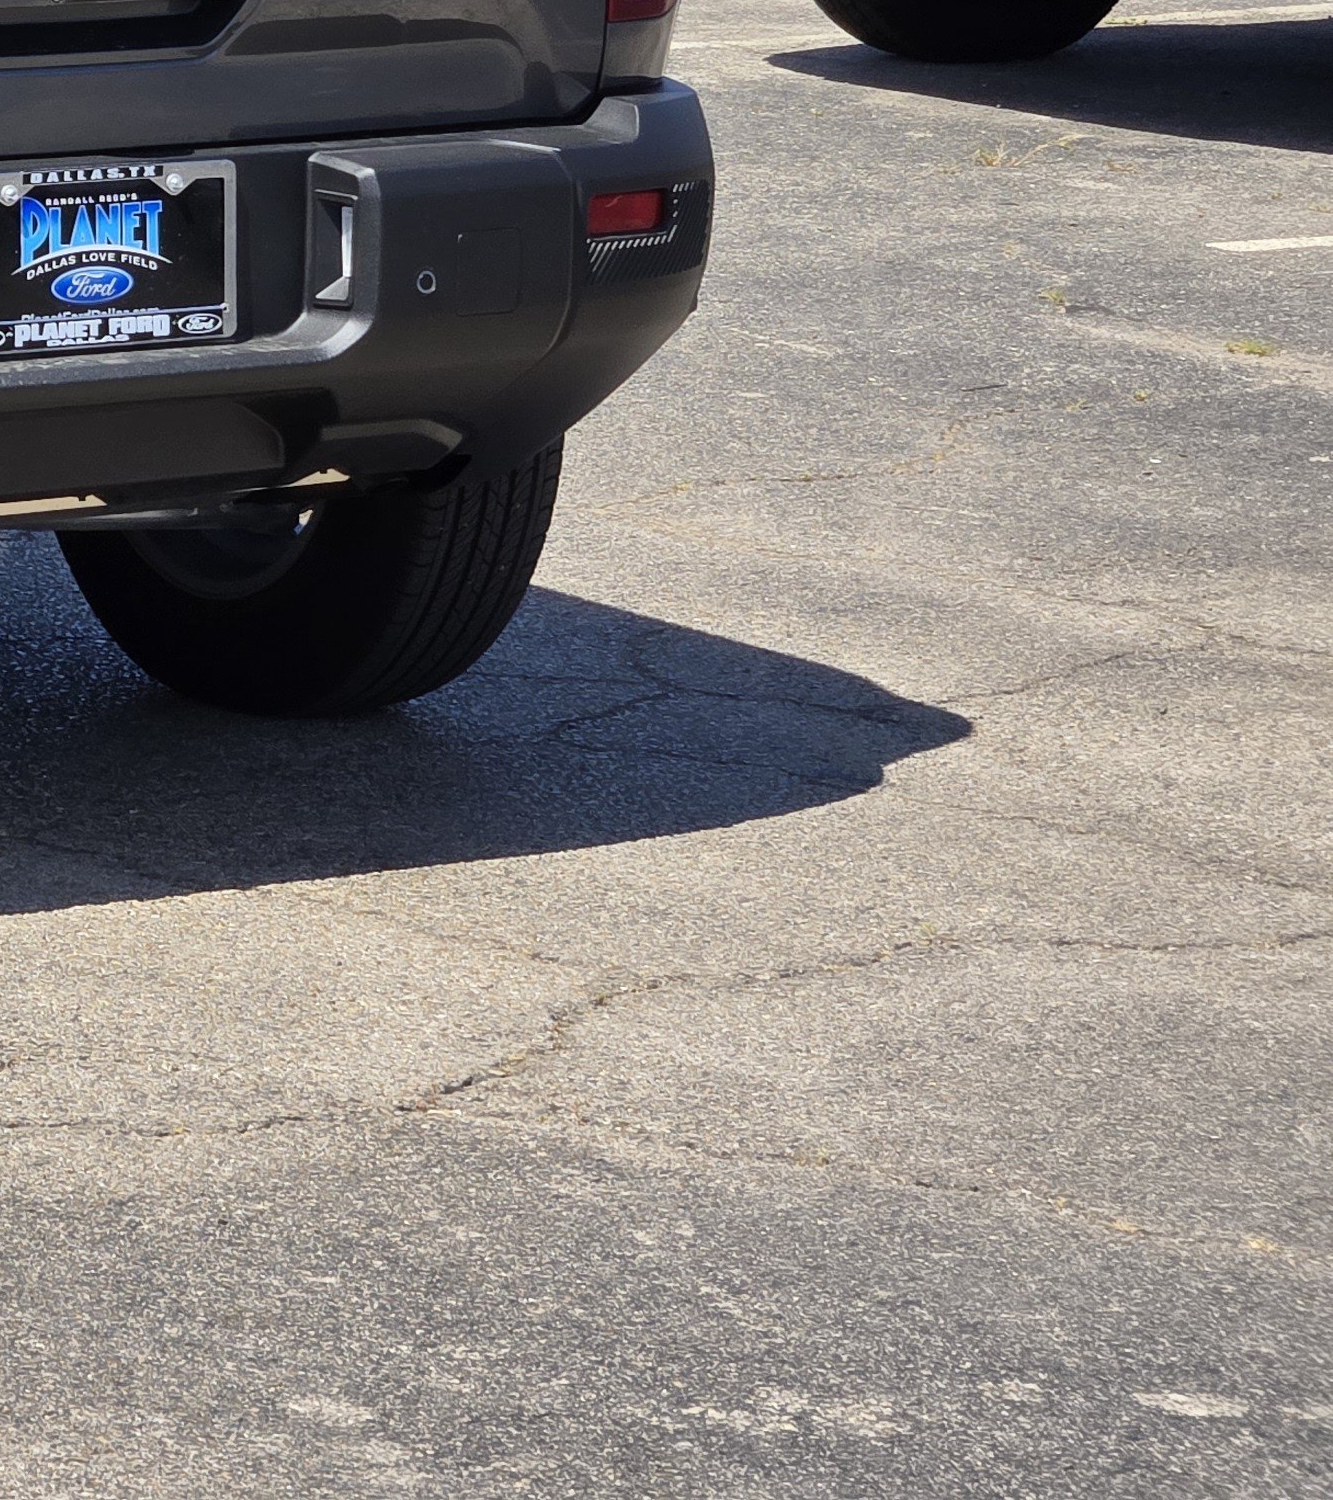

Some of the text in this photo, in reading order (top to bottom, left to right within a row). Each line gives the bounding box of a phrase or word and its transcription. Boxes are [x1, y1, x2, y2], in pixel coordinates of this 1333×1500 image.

[20, 196, 163, 266] PLANET
[26, 252, 159, 281] DALLAS LOVE FIELD
[66, 271, 116, 298] Ford
[14, 320, 103, 348] PLANET
[108, 315, 171, 337] FORD
